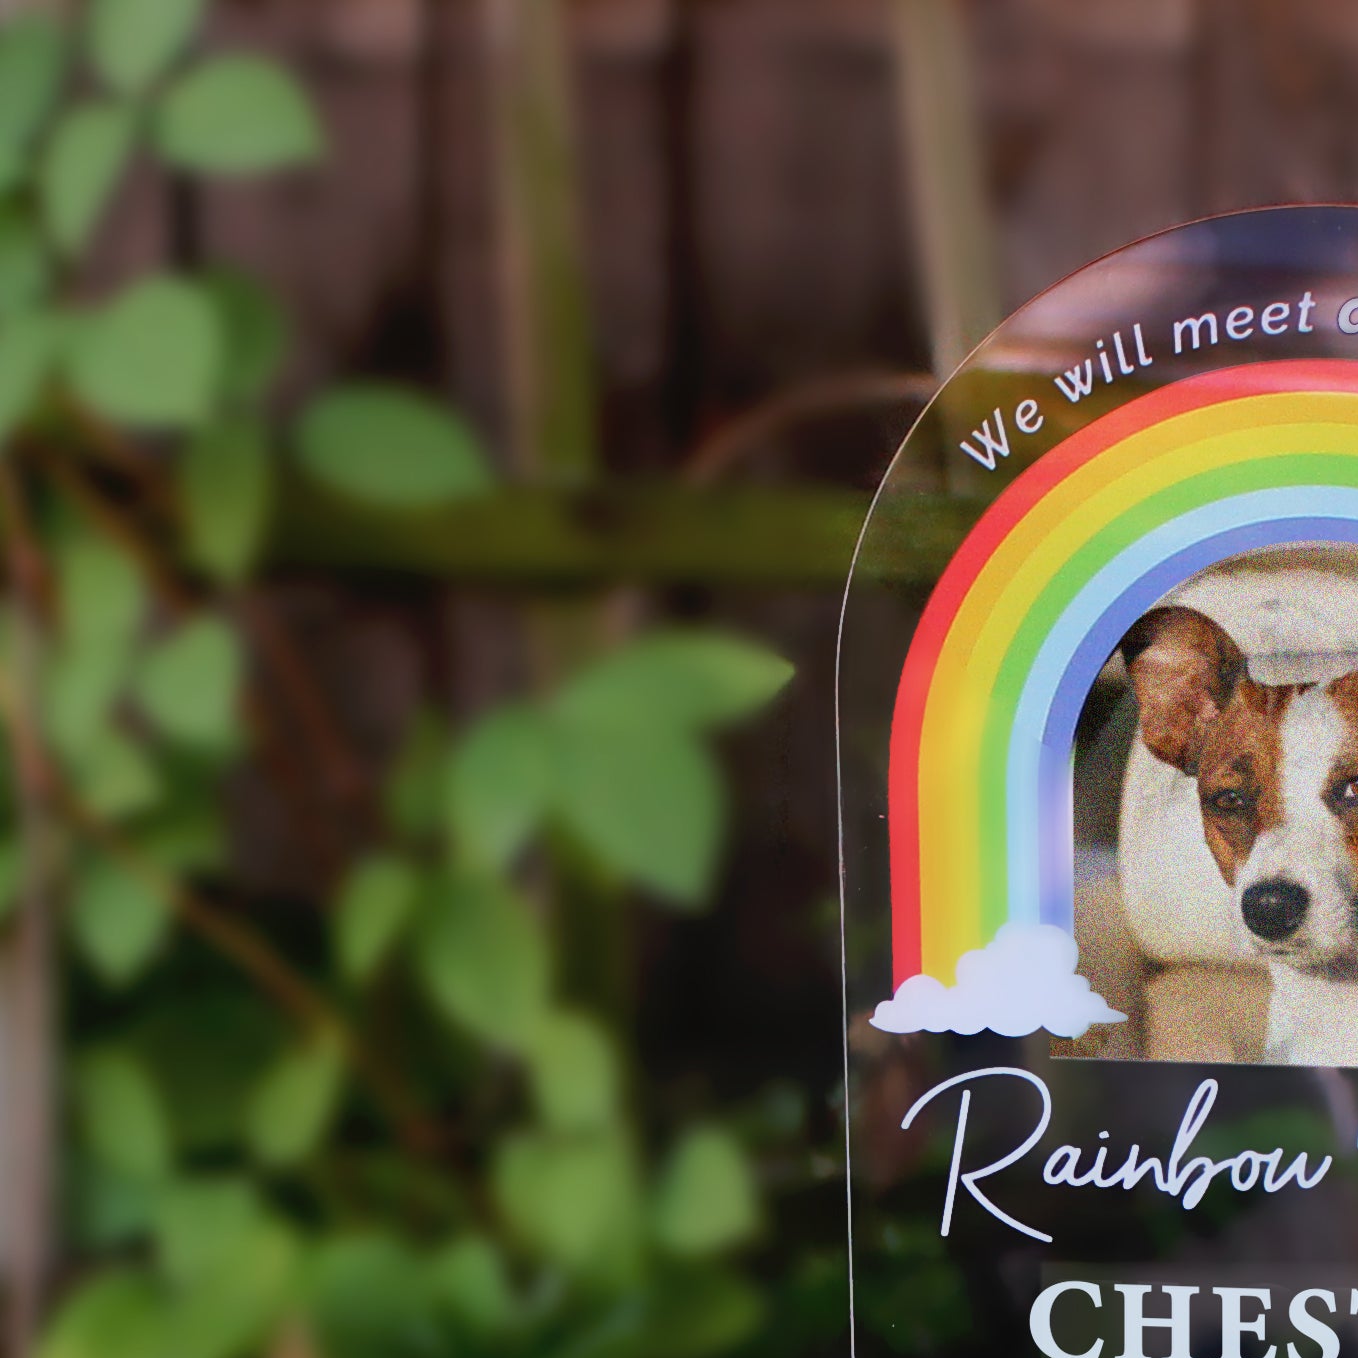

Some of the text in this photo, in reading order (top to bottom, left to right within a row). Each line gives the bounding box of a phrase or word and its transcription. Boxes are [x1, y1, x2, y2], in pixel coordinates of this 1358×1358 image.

[959, 395, 1044, 472] We
[1054, 323, 1154, 404] will
[1173, 291, 1317, 355] meet
[900, 1066, 1333, 1244] Rainbow
